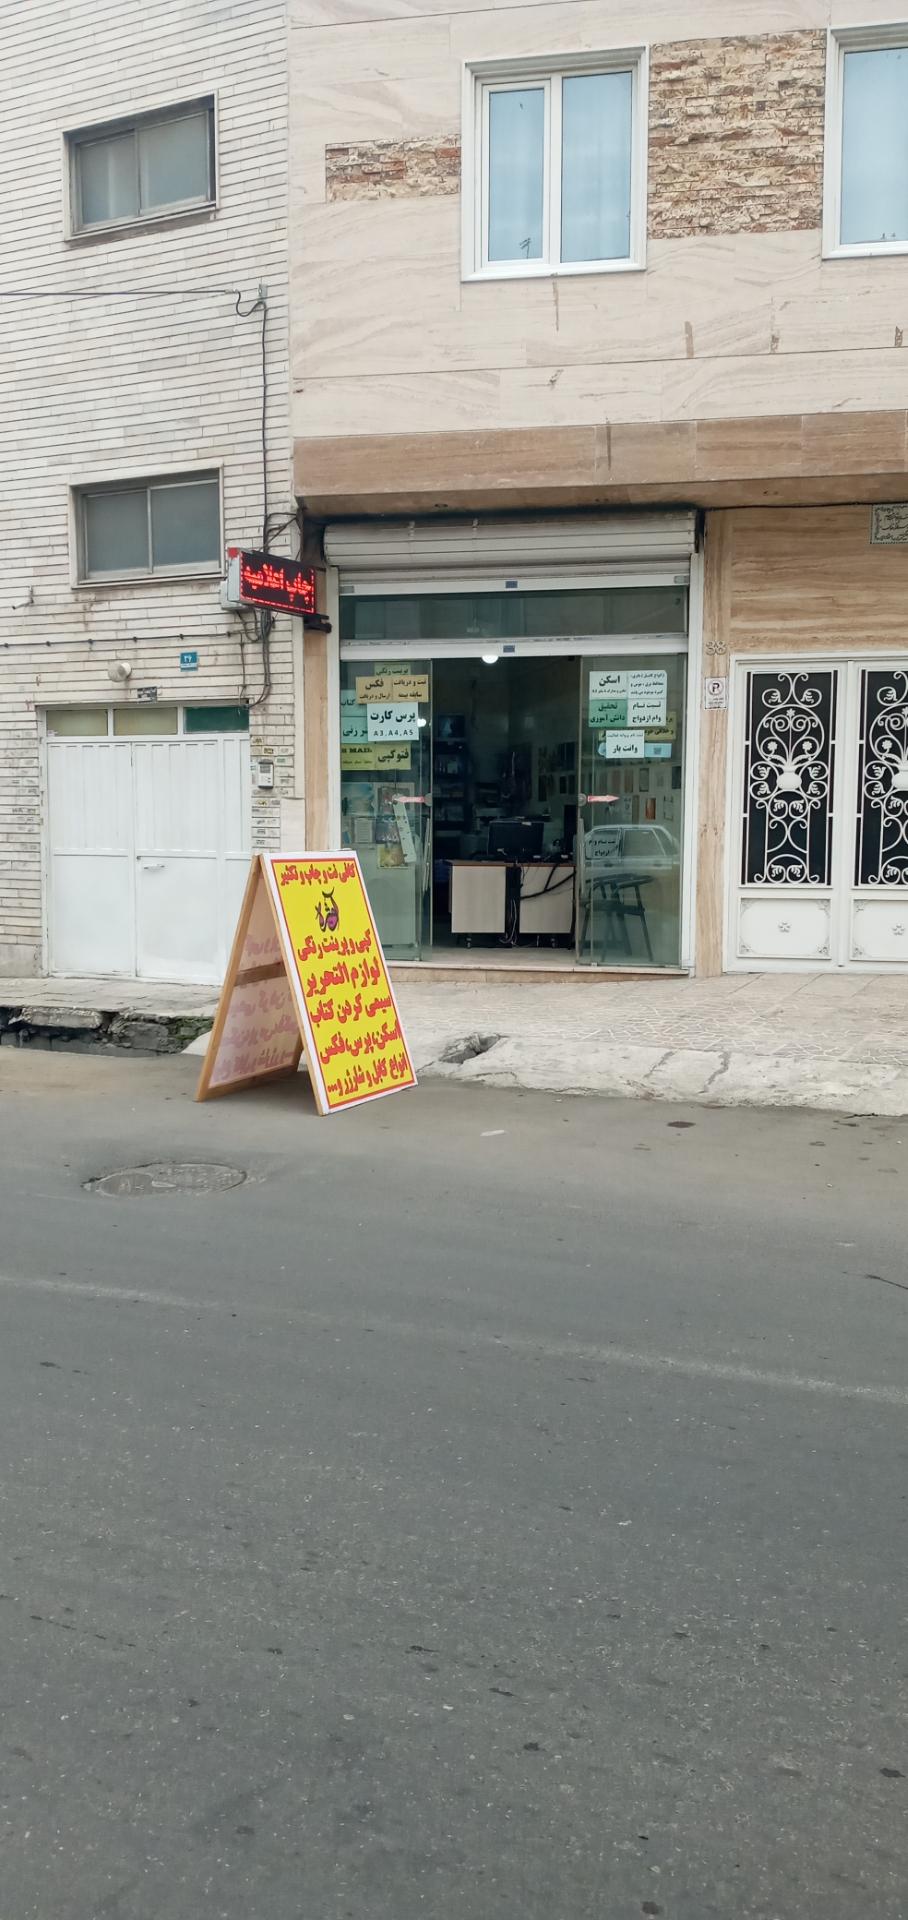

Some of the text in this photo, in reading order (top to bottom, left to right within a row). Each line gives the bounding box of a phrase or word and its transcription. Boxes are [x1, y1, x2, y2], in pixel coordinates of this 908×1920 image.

[243, 563, 312, 605] چاپ اعلامیه
[705, 641, 727, 656] 38
[365, 679, 385, 690] فکس
[599, 675, 621, 687] اسکن
[598, 702, 618, 712] تحقیق
[632, 702, 646, 710] نام
[370, 710, 416, 723] پرس کارت
[609, 713, 626, 723] دانش
[632, 714, 651, 723] ازدواج
[652, 714, 662, 723] وام
[377, 747, 410, 763] فتوکپی
[612, 744, 638, 753] وانت بار
[281, 865, 298, 886] تکثیر
[299, 871, 305, 885] و
[304, 864, 321, 886] چاپ
[327, 864, 338, 880] نت
[339, 862, 355, 882] کافی
[298, 935, 324, 961] رنگی
[321, 935, 348, 956] پرینت
[349, 938, 355, 955] و
[355, 928, 371, 953] کپی
[306, 956, 381, 998] لوازم التحریر
[310, 998, 335, 1029] کتاب
[365, 996, 391, 1017] سیمی
[372, 1058, 388, 1085] کابل
[389, 1052, 408, 1079] انواع
[345, 1065, 366, 1095] شارژر
[366, 1070, 373, 1088] و
